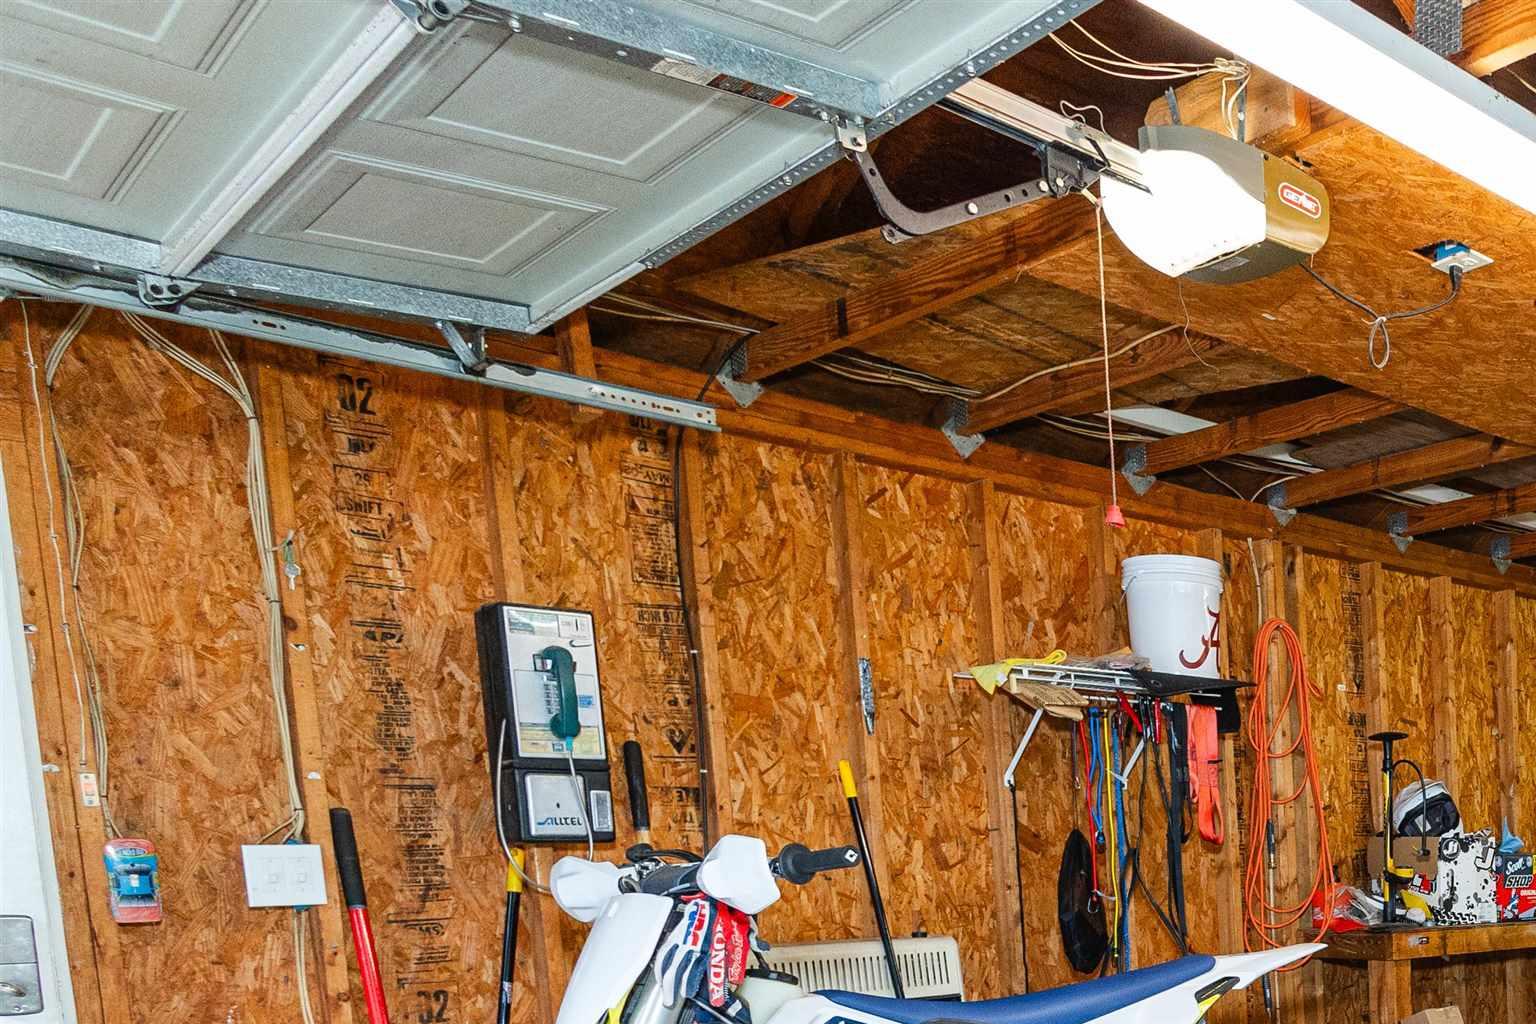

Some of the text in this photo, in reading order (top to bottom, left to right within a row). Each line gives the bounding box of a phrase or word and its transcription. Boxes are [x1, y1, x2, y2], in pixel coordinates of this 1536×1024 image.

[1282, 188, 1317, 213] GENIE
[537, 816, 582, 826] ALLTEL
[1505, 875, 1533, 889] SHOP
